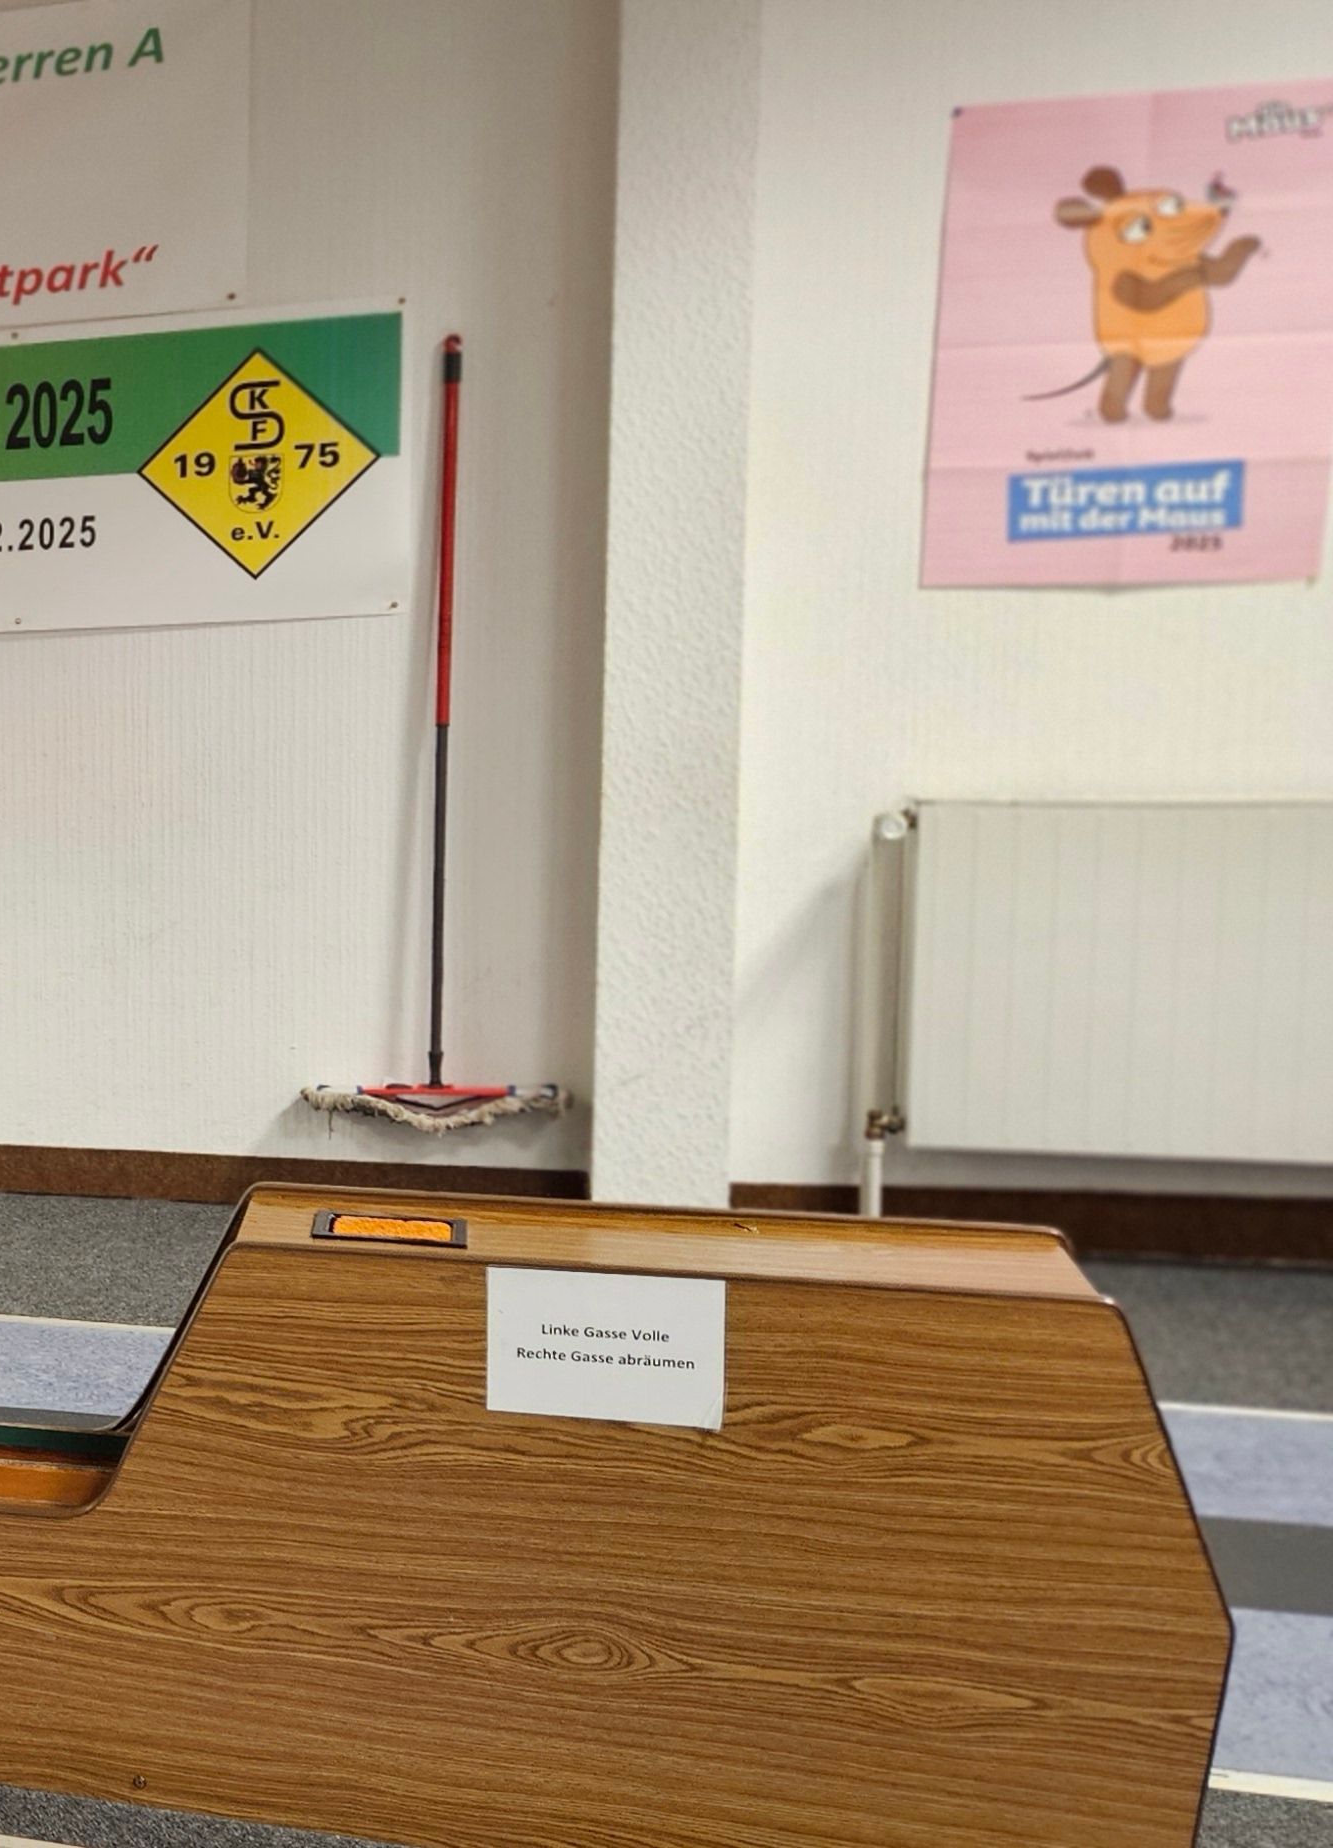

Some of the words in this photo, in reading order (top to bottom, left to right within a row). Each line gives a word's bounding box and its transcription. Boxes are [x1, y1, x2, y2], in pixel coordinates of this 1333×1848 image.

[128, 26, 166, 68] A
[5, 377, 114, 450] 2025
[174, 452, 216, 478] 19
[294, 442, 340, 469] 75
[1021, 474, 1146, 508] Türen
[1153, 468, 1230, 505] auf
[230, 521, 280, 541] e.V.
[1018, 507, 1074, 532] mit
[1078, 507, 1133, 530] der
[1137, 505, 1226, 529] Maus
[541, 1323, 579, 1337] Linke
[583, 1326, 627, 1340] Gasse
[632, 1329, 670, 1342] Volle
[516, 1346, 566, 1361] Rechte
[571, 1350, 614, 1364] Gasse
[618, 1354, 695, 1370] abräumen
